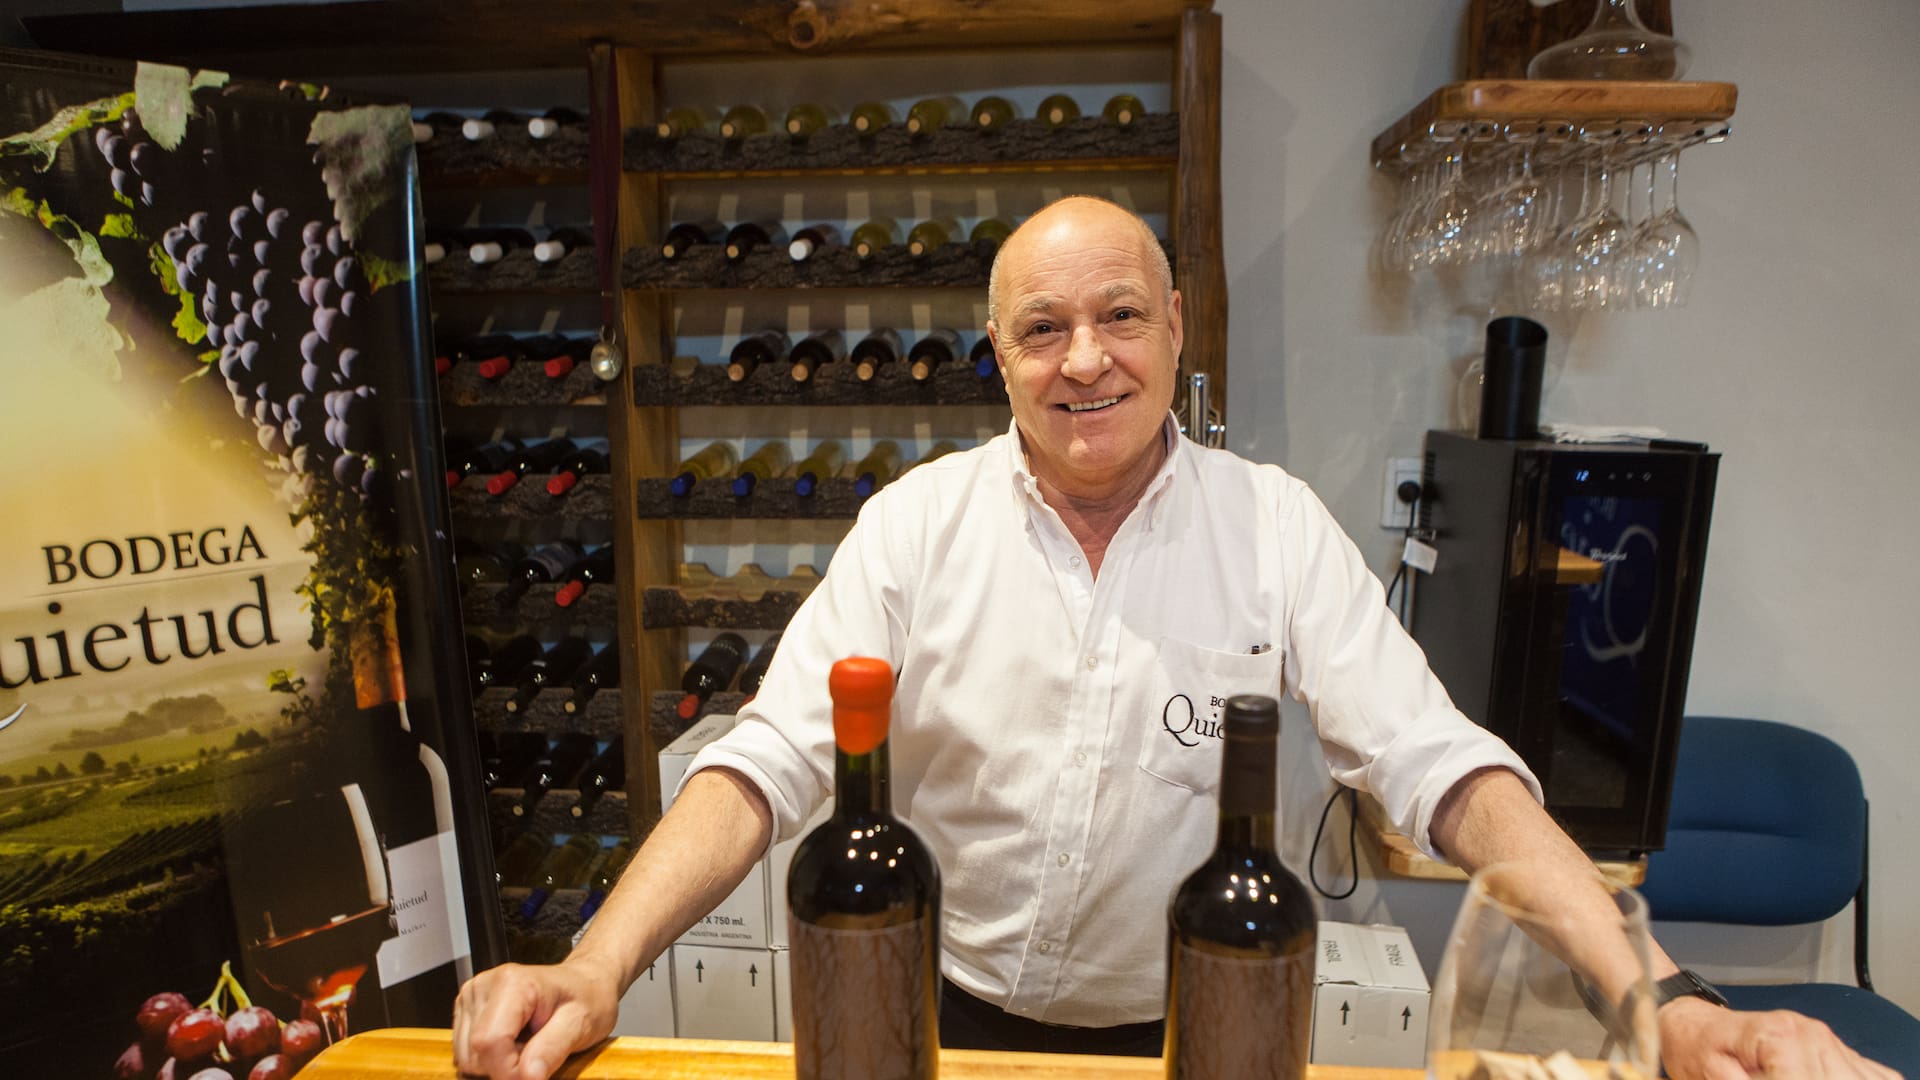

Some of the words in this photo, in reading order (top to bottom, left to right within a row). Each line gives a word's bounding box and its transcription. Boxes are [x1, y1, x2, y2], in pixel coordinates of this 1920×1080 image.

[41, 525, 269, 586] BODEGA
[0, 575, 281, 691] uietud
[1163, 694, 1225, 747] Quie
[395, 889, 429, 910] uietud
[714, 916, 730, 925] 750
[721, 932, 753, 940] ARGENTINA
